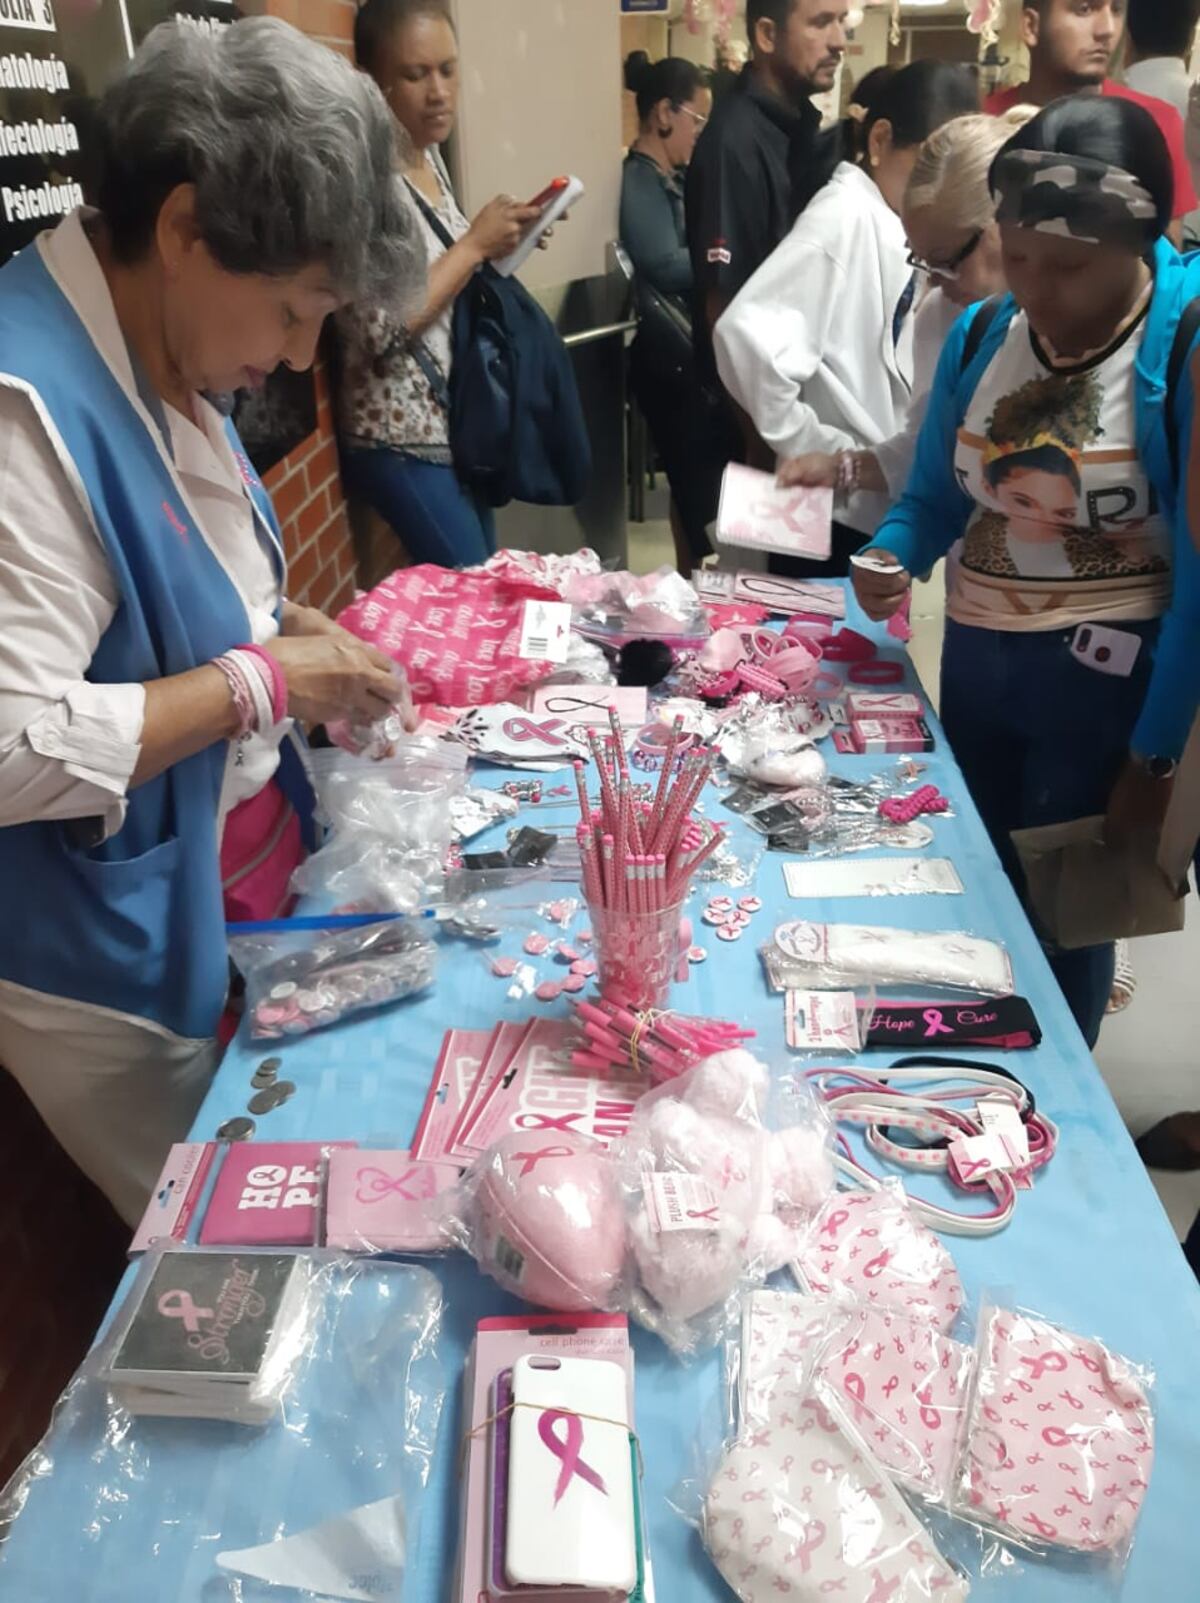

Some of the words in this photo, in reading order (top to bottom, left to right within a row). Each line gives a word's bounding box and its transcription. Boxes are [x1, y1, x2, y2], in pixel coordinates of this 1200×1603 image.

[2, 176, 84, 222] Psicologia
[869, 1014, 915, 1031] Hope
[957, 1010, 997, 1025] Cure
